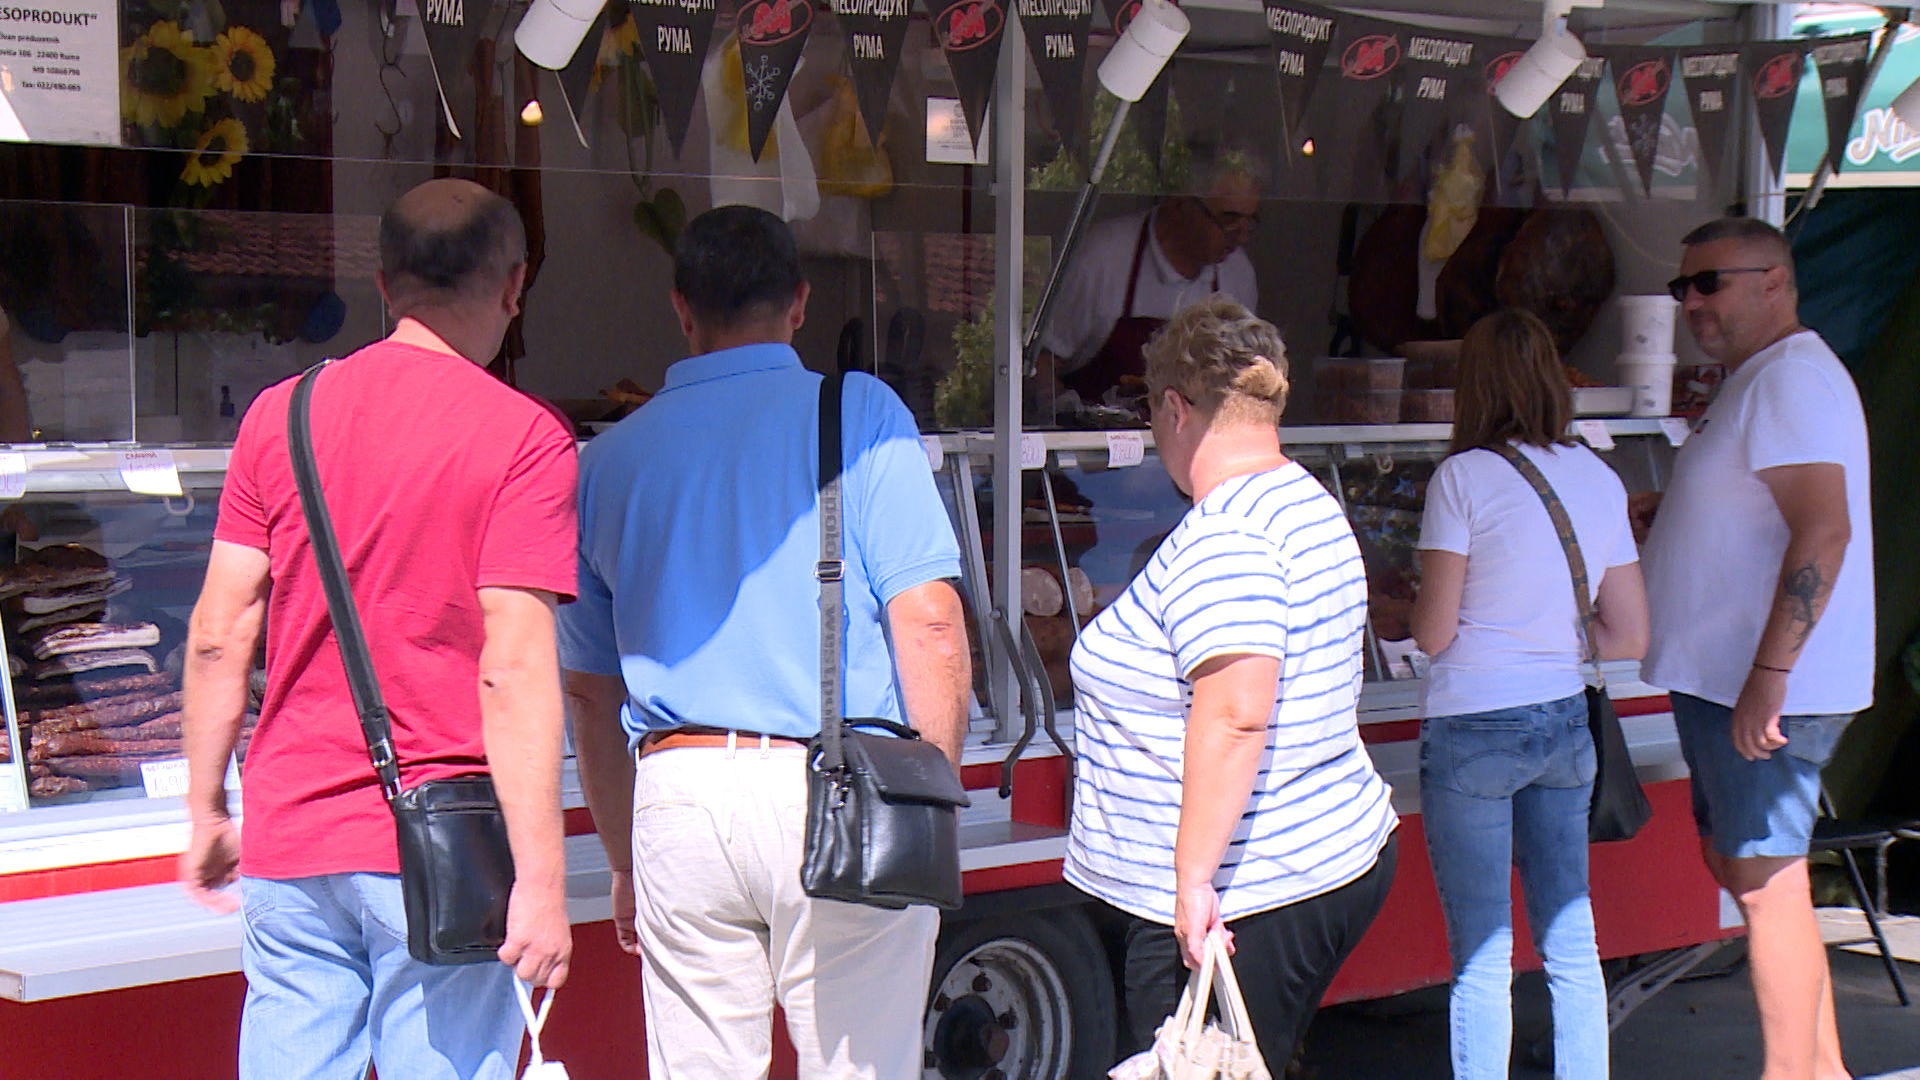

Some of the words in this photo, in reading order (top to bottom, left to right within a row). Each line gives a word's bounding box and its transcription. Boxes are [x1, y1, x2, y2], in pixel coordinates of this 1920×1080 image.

[426, 0, 464, 26] РУМА
[1267, 7, 1334, 43] МЕСОПРОДУКТ
[657, 25, 692, 54] РУМА
[853, 34, 884, 59] РУМА
[1045, 34, 1075, 58] РУМА
[1407, 36, 1474, 67] МЕСОПРОДУКТ
[1279, 50, 1305, 77] РУМА
[1416, 77, 1447, 100] РУМА
